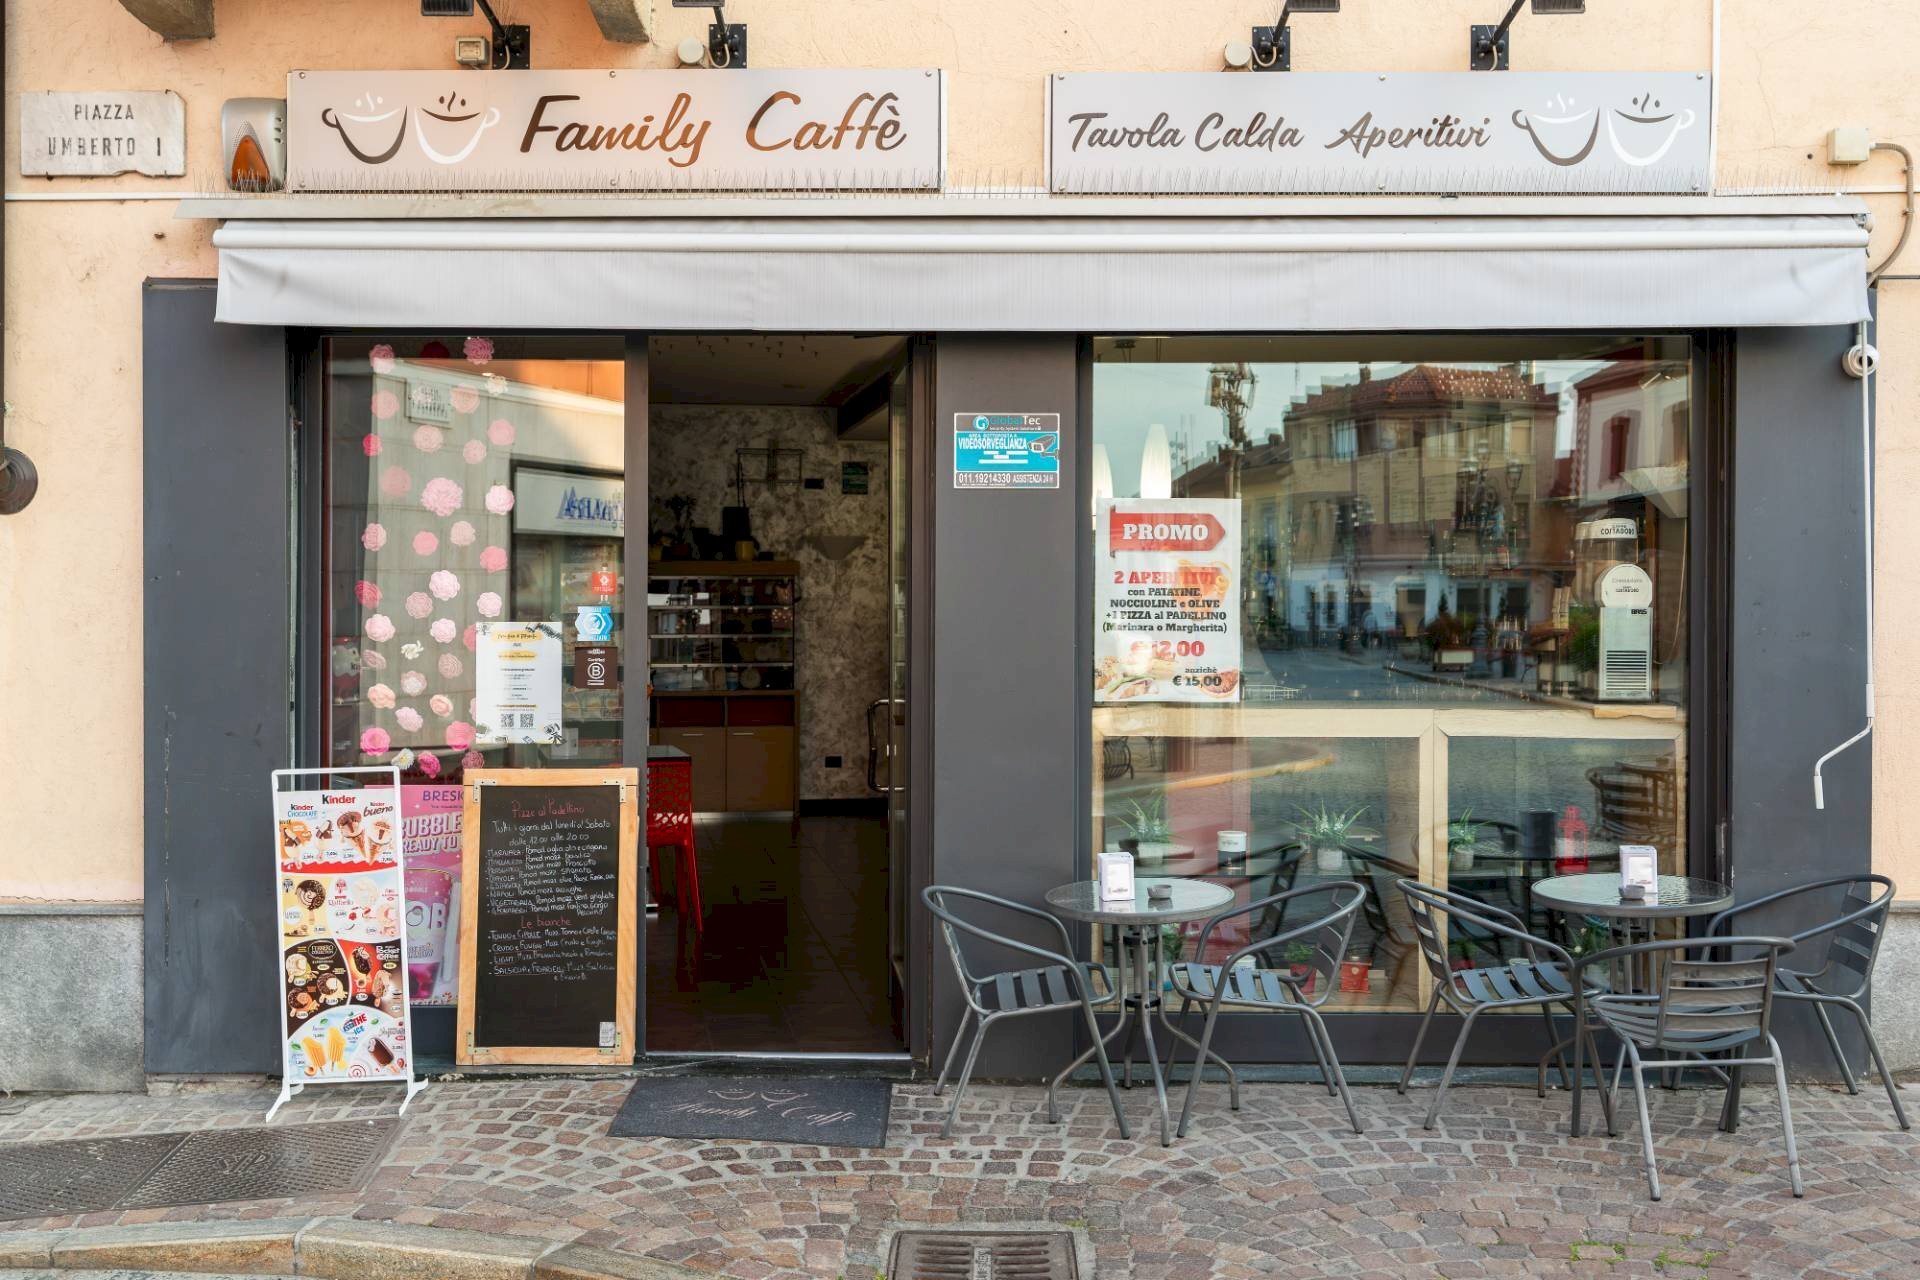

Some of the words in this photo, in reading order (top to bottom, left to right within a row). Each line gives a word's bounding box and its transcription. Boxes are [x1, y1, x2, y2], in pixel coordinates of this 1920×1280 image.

[74, 104, 135, 122] PIAZZA
[519, 92, 712, 168] Family
[745, 91, 908, 151] Caffè
[1067, 111, 1187, 152] Tavola
[1194, 111, 1305, 153] Calda
[1324, 111, 1491, 159] Aperitivi
[49, 136, 136, 157] UMBERTO
[958, 437, 1027, 450] VIDEOSORVEGLIANZA
[1123, 524, 1209, 541] PROMO
[1114, 570, 1124, 584] 2
[1128, 570, 1217, 585] APETIVI
[1127, 589, 1146, 597] con
[1148, 588, 1203, 598] PATATINE,
[1110, 599, 1177, 608] NOCCIOLINE
[1187, 599, 1220, 608] OLIVE
[1120, 611, 1152, 620] PIZZA
[1154, 611, 1164, 620] al
[1166, 611, 1227, 620] PADELLINO
[1156, 624, 1163, 632] o
[1165, 622, 1228, 634] Margherita)
[1172, 676, 1182, 686] €
[1185, 676, 1222, 688] 15,00
[363, 806, 393, 817] bueno
